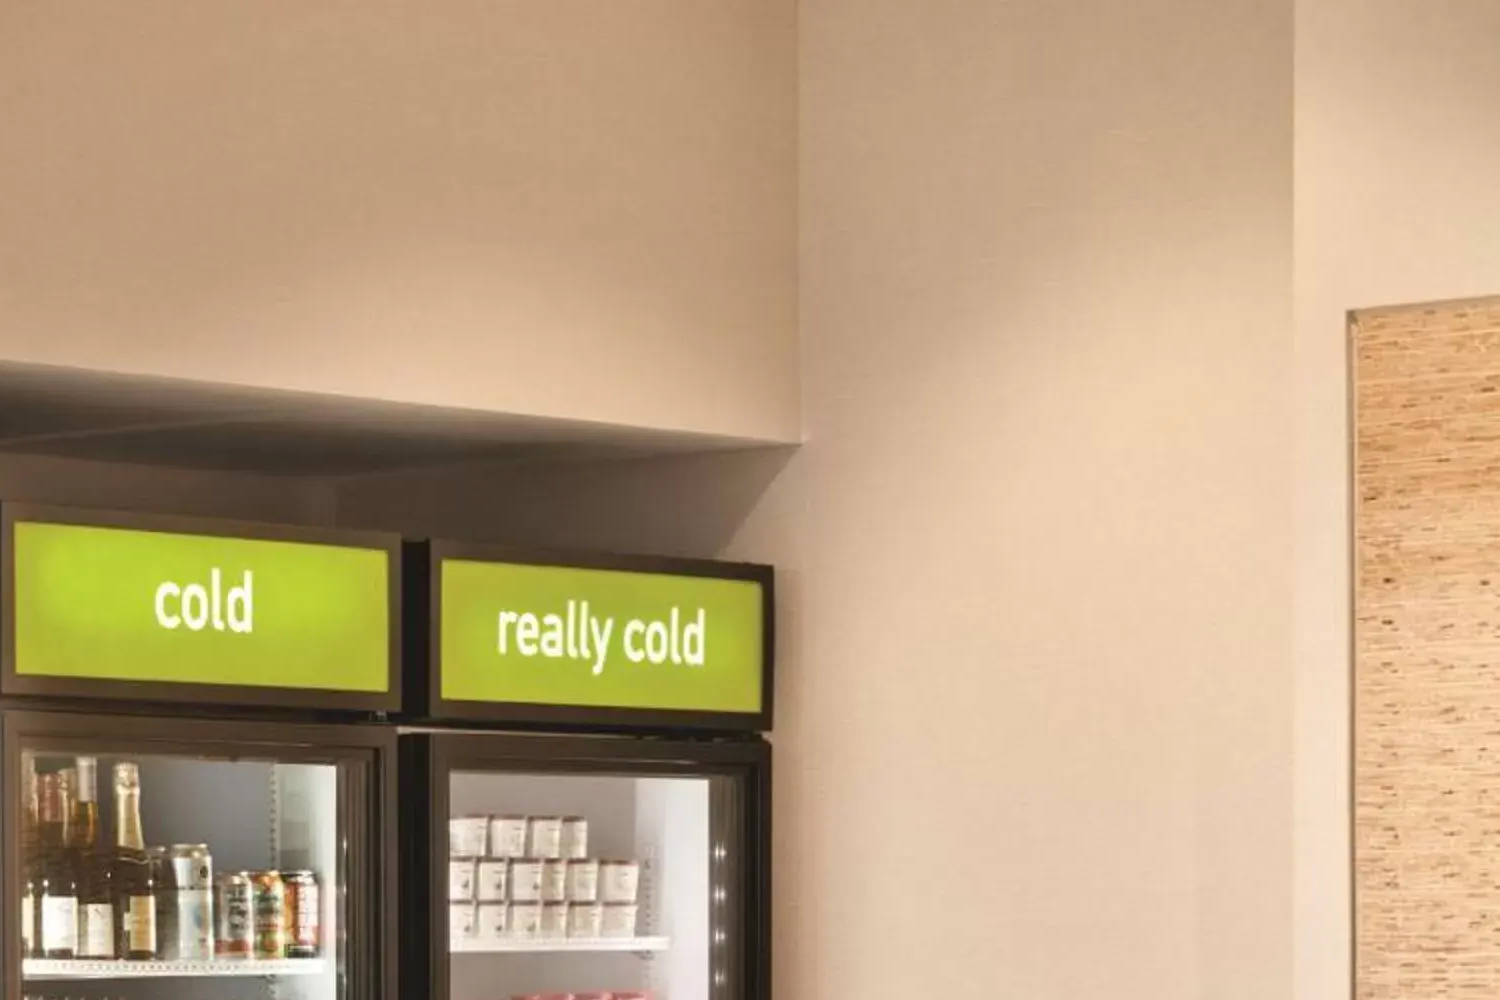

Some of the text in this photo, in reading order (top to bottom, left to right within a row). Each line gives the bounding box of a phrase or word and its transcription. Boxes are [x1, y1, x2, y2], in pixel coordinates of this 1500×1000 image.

[153, 567, 254, 633] cold
[497, 600, 706, 675] really cold
